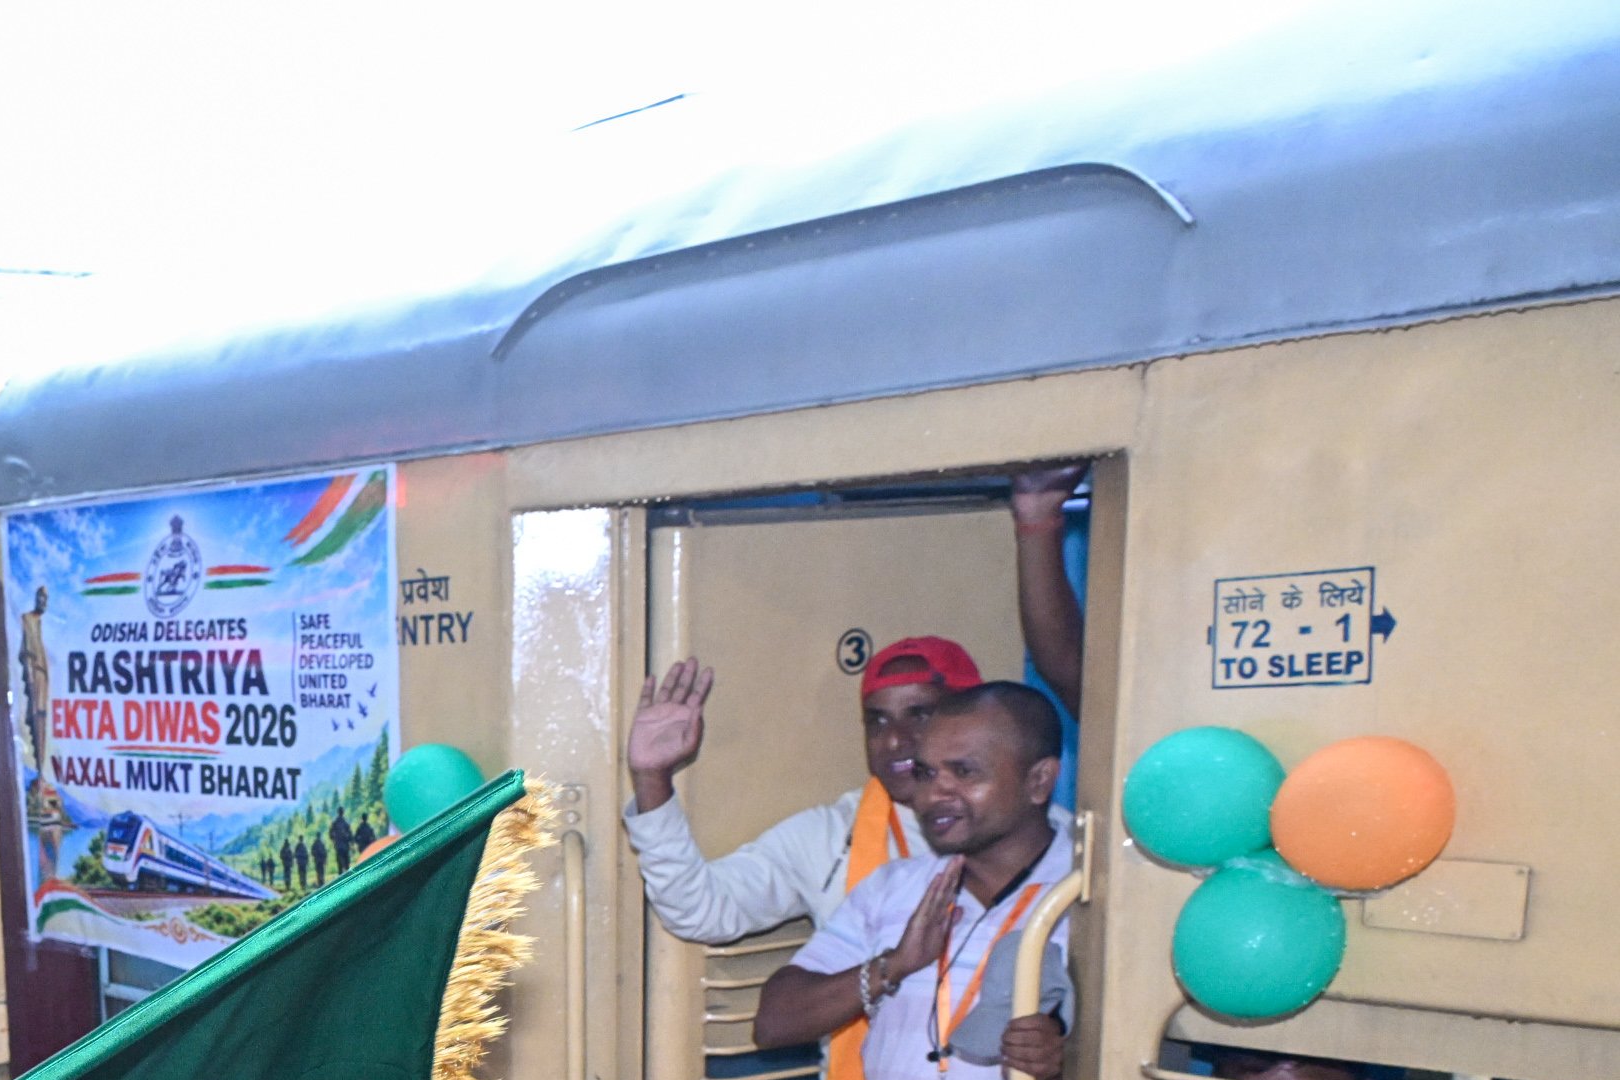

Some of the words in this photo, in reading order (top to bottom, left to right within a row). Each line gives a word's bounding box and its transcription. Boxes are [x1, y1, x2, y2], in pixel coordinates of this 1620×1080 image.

[399, 567, 450, 605] प्रवेश
[1222, 587, 1266, 614] सोने
[1281, 583, 1304, 610] के
[1318, 579, 1365, 608] लिये
[91, 622, 148, 643] ODISHA
[153, 617, 248, 642] DELEGATES
[300, 613, 330, 630] SAFE
[397, 611, 474, 646] NTRY
[1231, 619, 1271, 649] 72
[1335, 612, 1351, 642] 1
[301, 633, 363, 650] PEACEFUL
[845, 636, 866, 667] 3
[68, 648, 270, 696] RASHTRIYA
[299, 653, 374, 670] DEVELOPED
[1220, 657, 1258, 680] TO
[1268, 651, 1364, 677] SLEEP
[298, 673, 347, 690] UNITED
[300, 693, 351, 709] BHARAT
[52, 698, 118, 741] EKTA
[123, 700, 221, 745] DIWAS
[225, 703, 298, 748] 2026
[126, 760, 193, 794] MUKT
[200, 763, 302, 800] BHARAT
